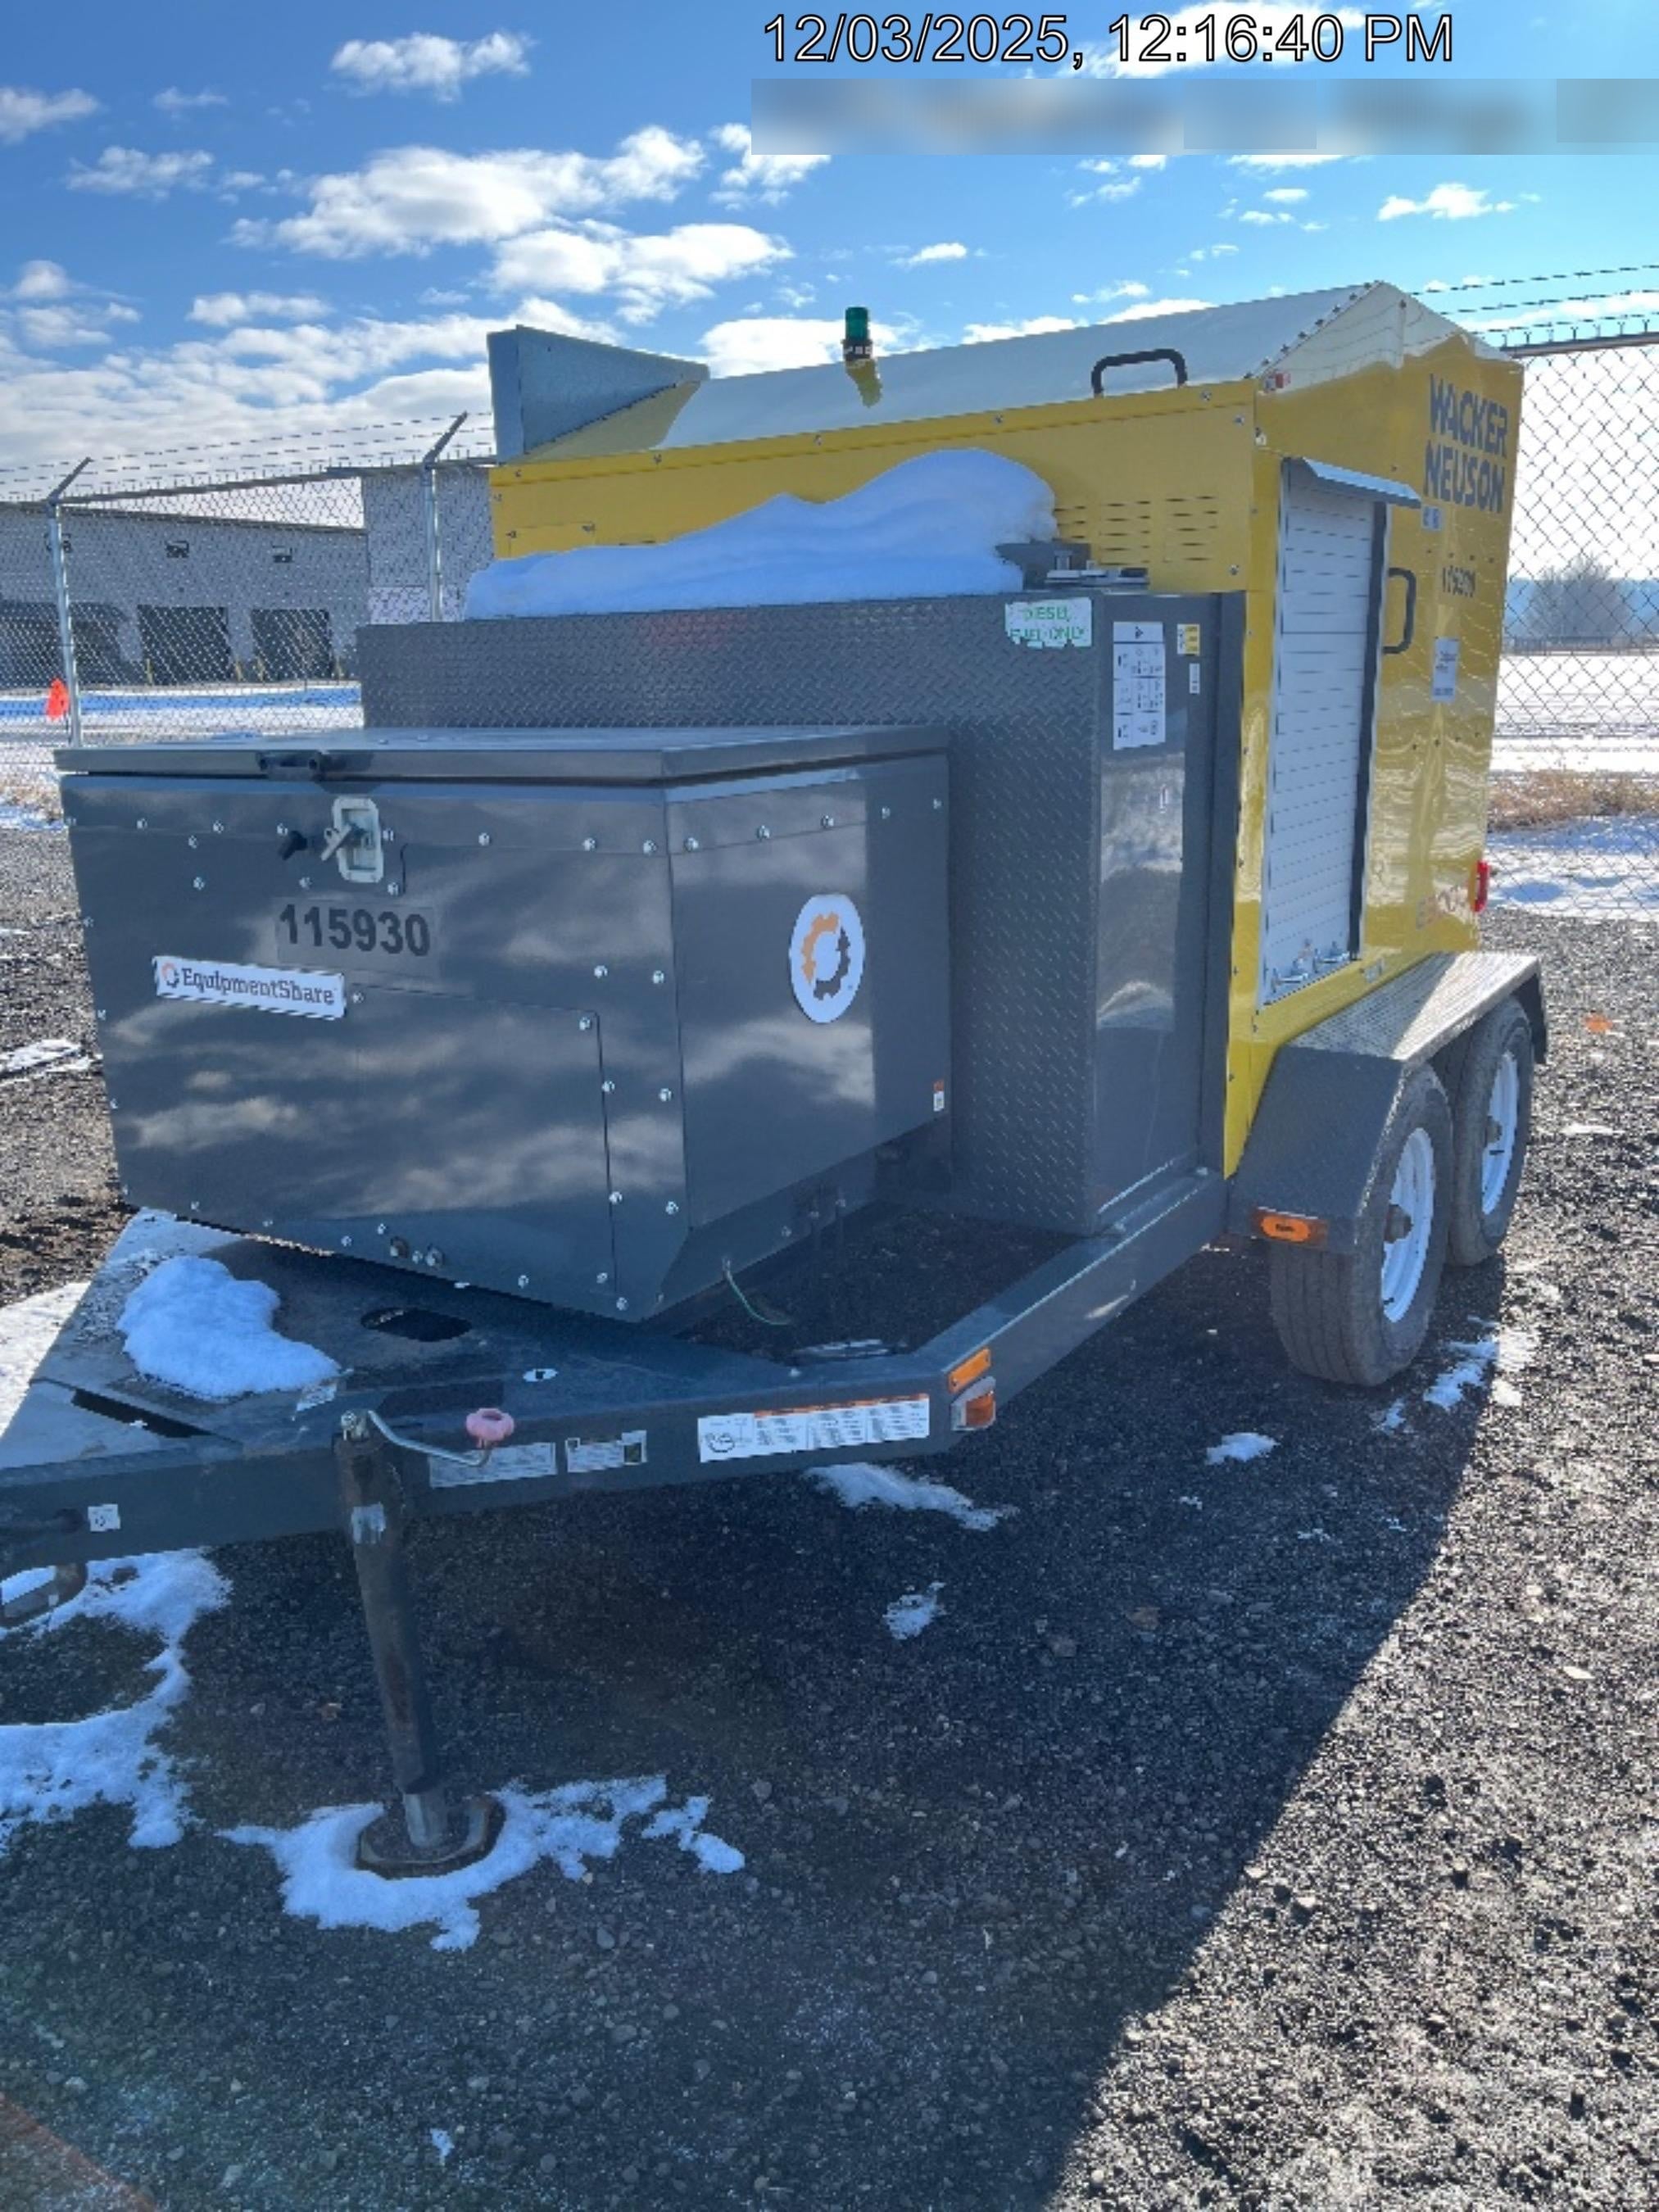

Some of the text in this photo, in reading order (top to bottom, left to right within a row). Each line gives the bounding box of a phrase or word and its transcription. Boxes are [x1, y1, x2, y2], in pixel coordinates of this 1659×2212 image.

[1429, 373, 1508, 460] WACKER
[1423, 438, 1506, 514] NEUSON
[279, 904, 430, 957] 115930
[181, 968, 336, 1005] EquipmentShare
